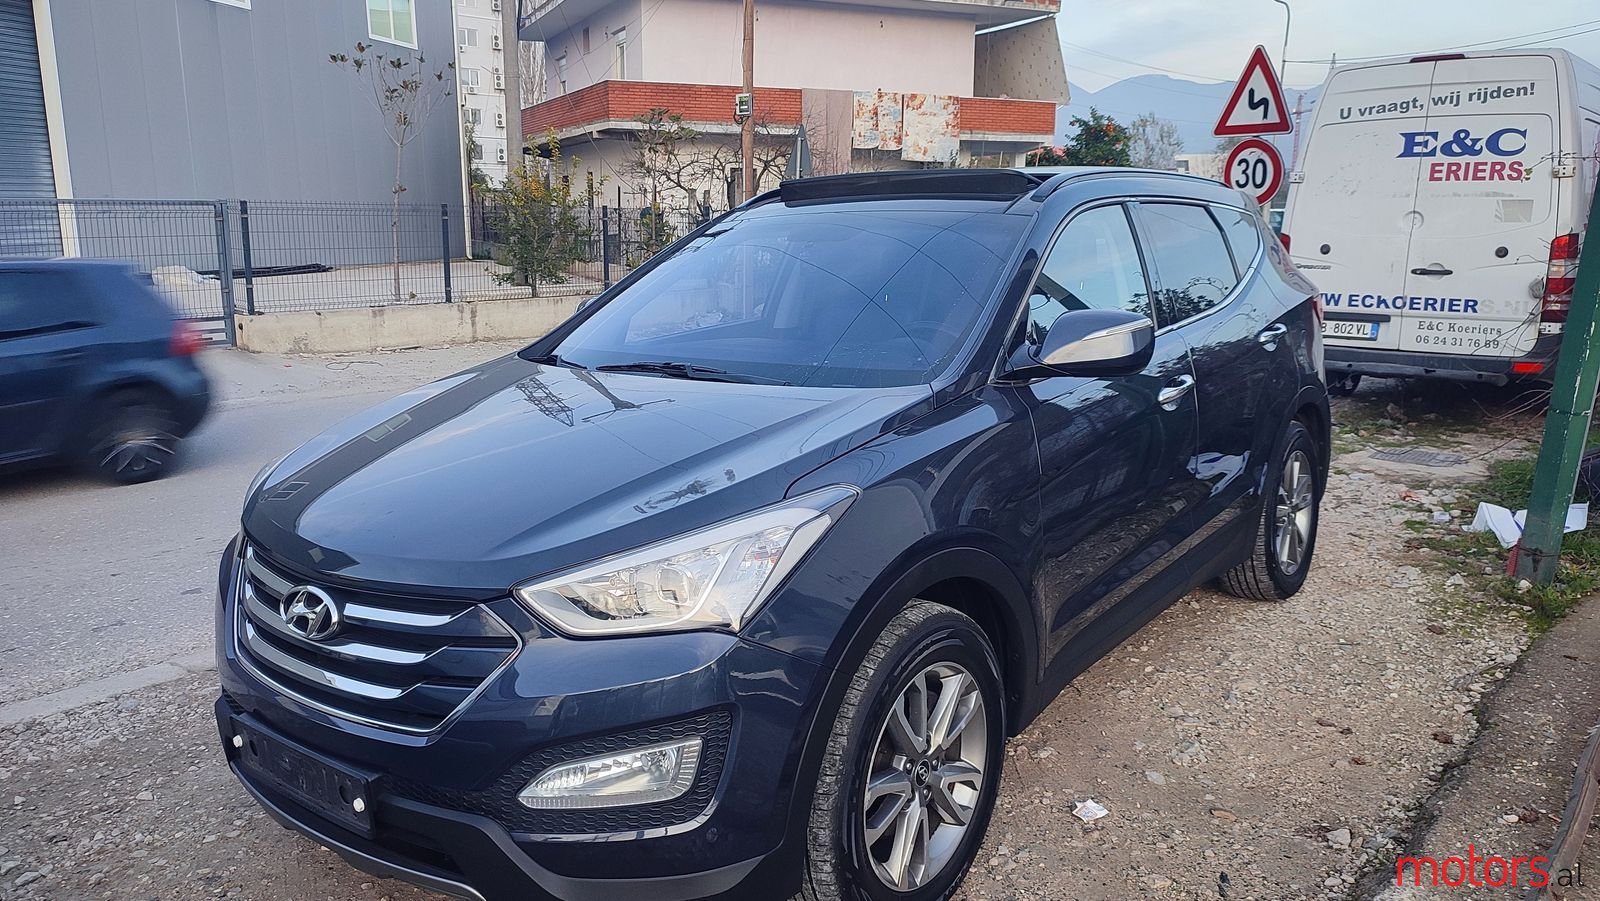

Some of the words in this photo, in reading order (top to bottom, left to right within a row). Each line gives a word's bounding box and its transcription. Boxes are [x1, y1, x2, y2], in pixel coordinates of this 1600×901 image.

[1339, 107, 1352, 120] U
[1358, 96, 1425, 116] vraagt,
[1431, 91, 1461, 107] wij
[1468, 82, 1536, 104] rijden!
[1396, 128, 1528, 158] E&C
[1235, 158, 1267, 189] 30
[1428, 161, 1524, 182] ERIERS
[1417, 321, 1444, 332] E&C
[1447, 322, 1502, 335] Koeriers
[1415, 335, 1430, 344] 06
[1433, 336, 1447, 345] 24
[1450, 337, 1463, 347] 31
[1467, 338, 1480, 348] 76
